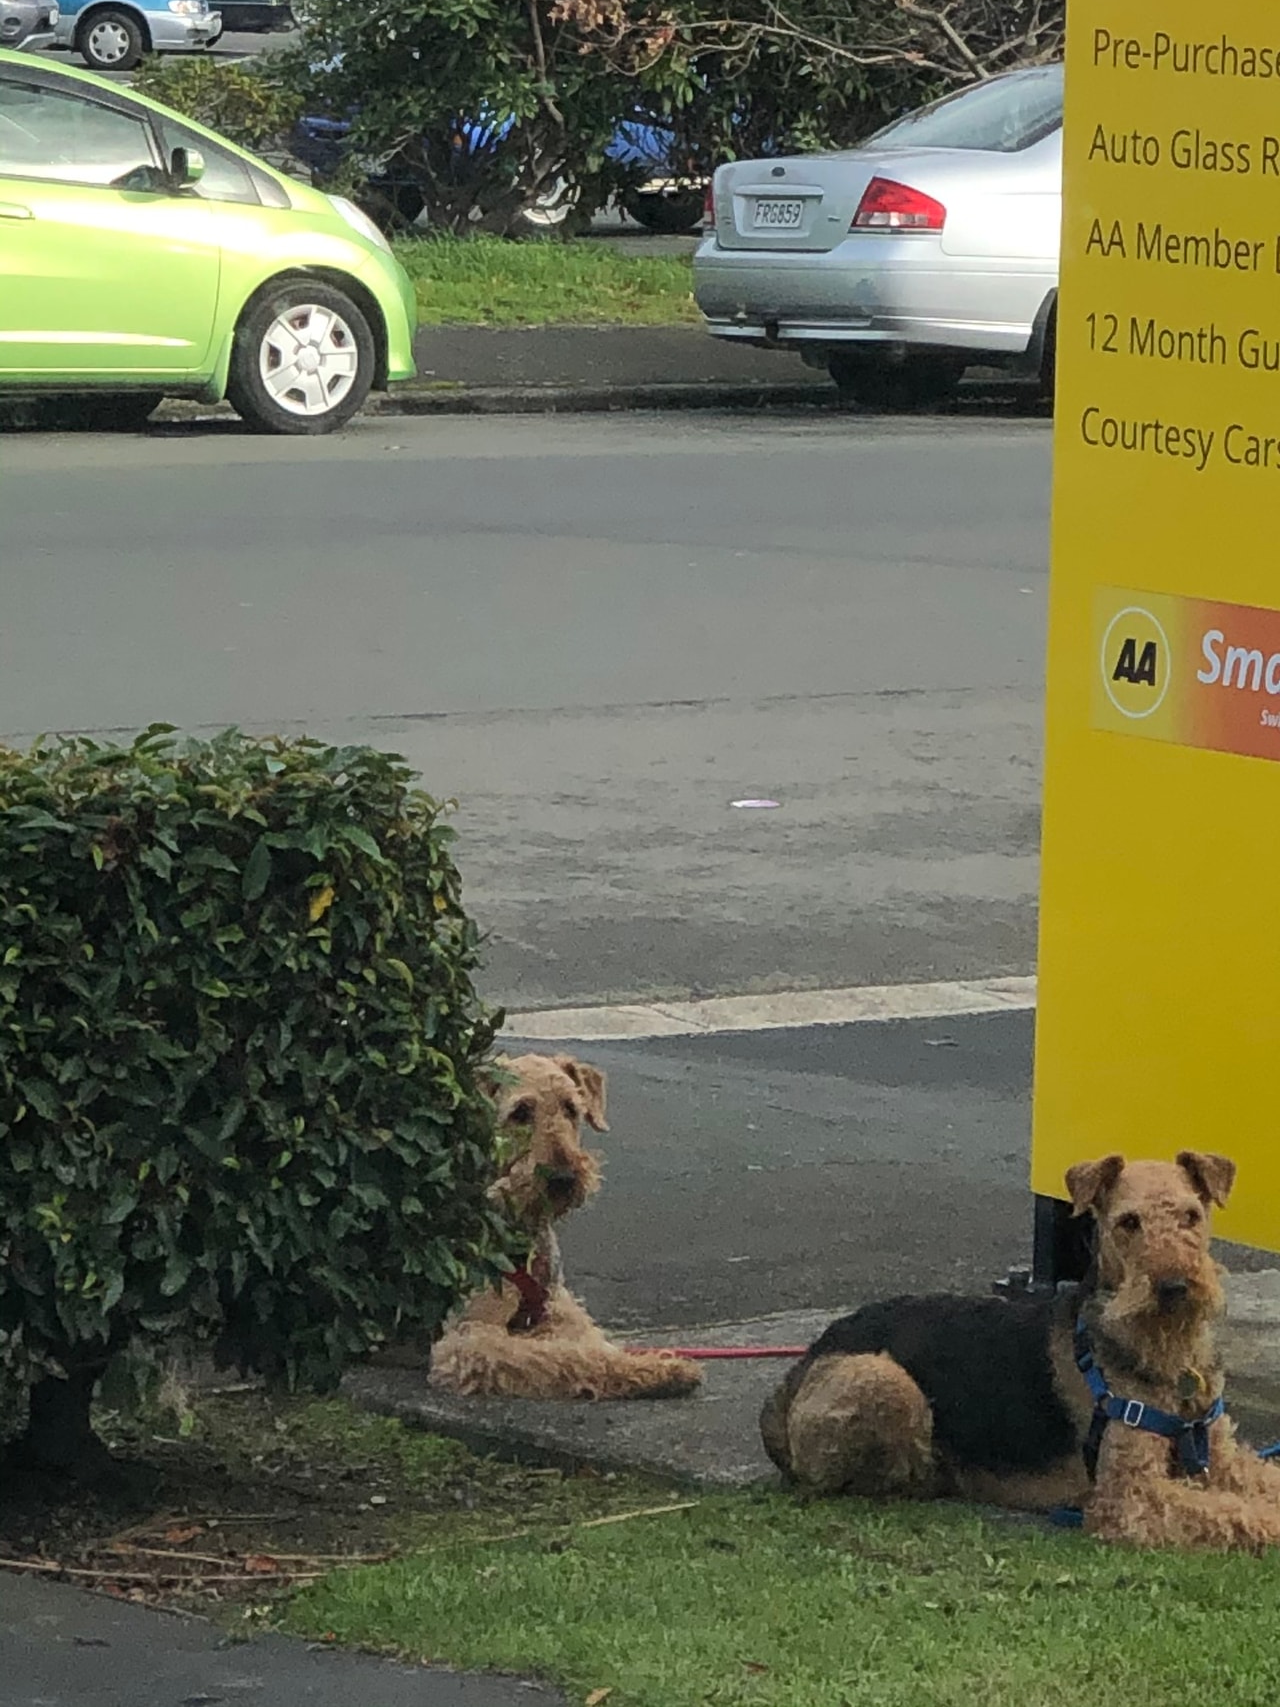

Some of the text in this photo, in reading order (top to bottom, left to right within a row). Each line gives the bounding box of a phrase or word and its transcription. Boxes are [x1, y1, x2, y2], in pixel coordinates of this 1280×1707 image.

[1087, 123, 1160, 167] Auto
[1170, 128, 1251, 175] Glass
[754, 203, 801, 224] FRG859
[1085, 218, 1127, 259] AA
[1136, 221, 1265, 272] Member
[1085, 311, 1119, 354] 12
[1129, 316, 1227, 365] Month
[1081, 406, 1215, 472] Courtesy
[1111, 637, 1157, 687] AA
